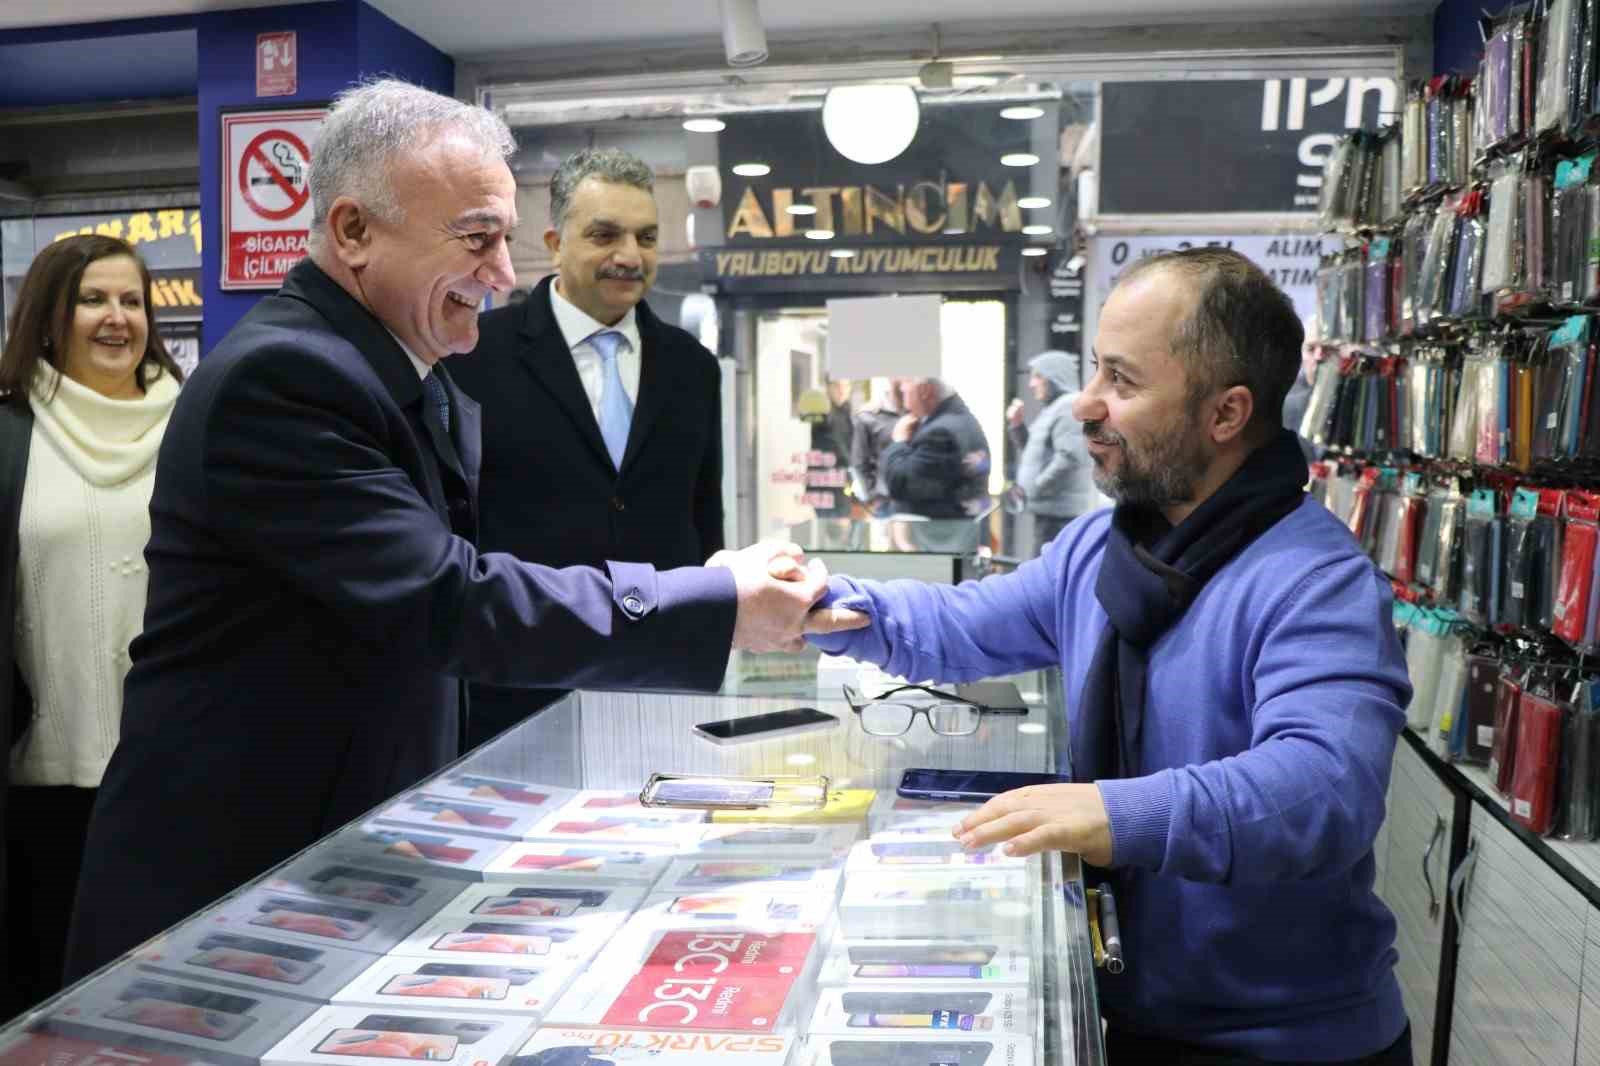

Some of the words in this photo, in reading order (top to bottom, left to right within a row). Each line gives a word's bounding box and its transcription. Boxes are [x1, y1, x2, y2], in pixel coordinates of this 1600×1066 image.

[245, 233, 310, 253] SİGARA
[673, 932, 745, 974] 13C
[637, 976, 720, 1025] 13C
[711, 985, 744, 1017] Redmi
[652, 1031, 786, 1055] SPARK
